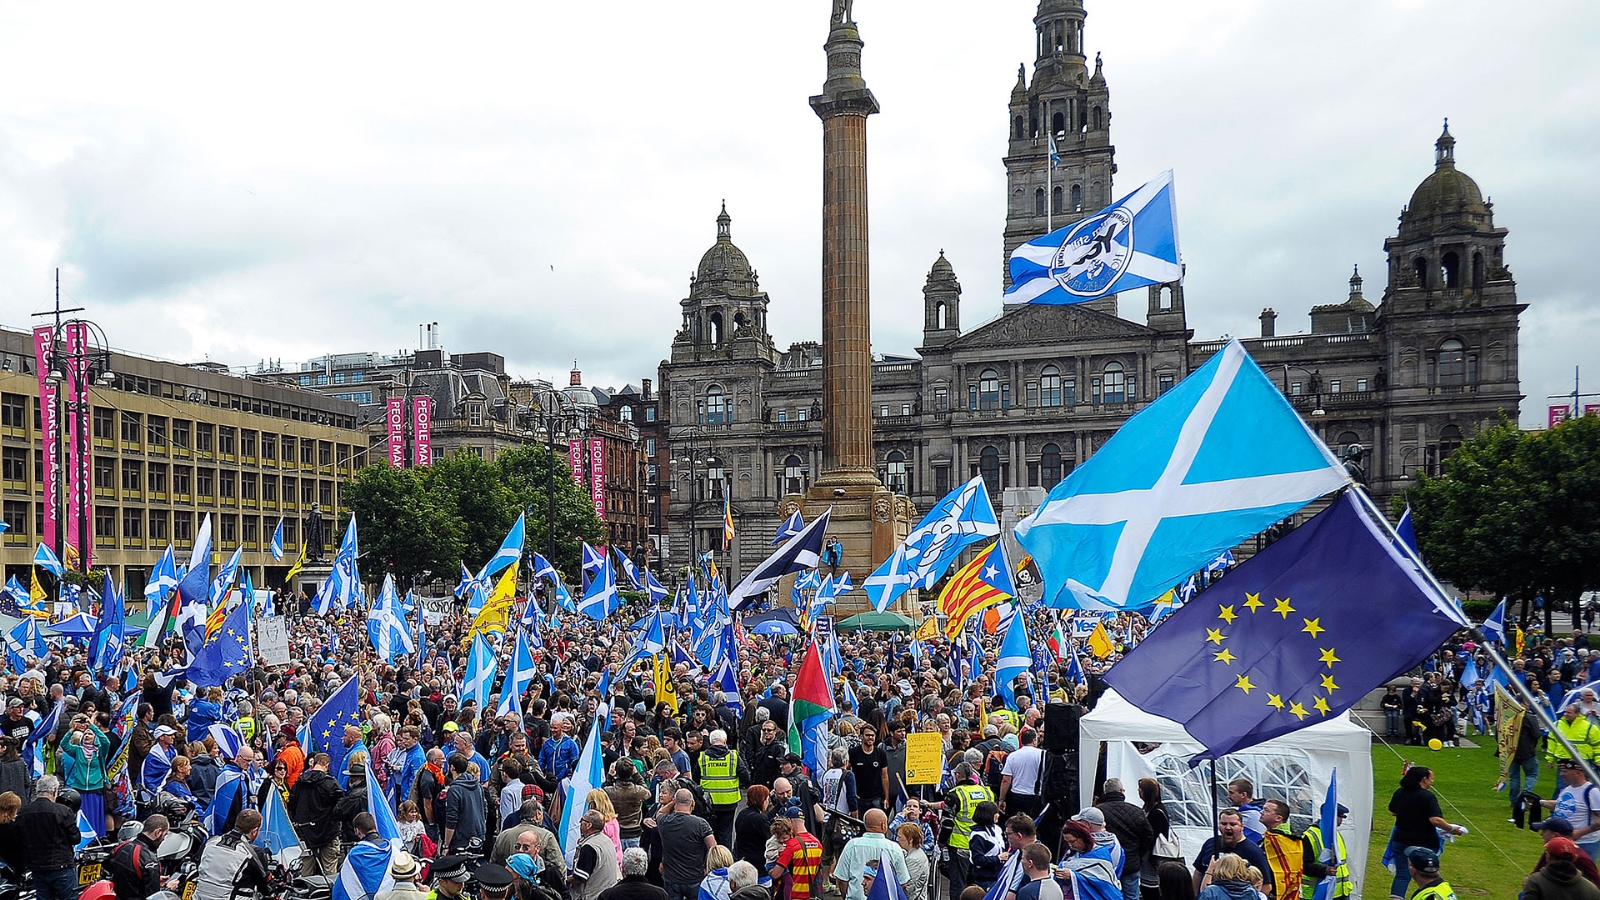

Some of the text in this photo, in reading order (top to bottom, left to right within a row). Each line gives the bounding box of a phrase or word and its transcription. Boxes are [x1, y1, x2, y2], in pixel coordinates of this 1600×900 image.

[46, 394, 57, 439] MAKE
[391, 401, 402, 442] PEOPLE
[418, 400, 428, 441] PEOPLE
[572, 441, 582, 473] PEOPLE
[593, 440, 603, 473] PEOPLE
[49, 441, 57, 520] GLASGOW
[594, 474, 603, 500] MAKE
[1075, 619, 1099, 633] Yes
